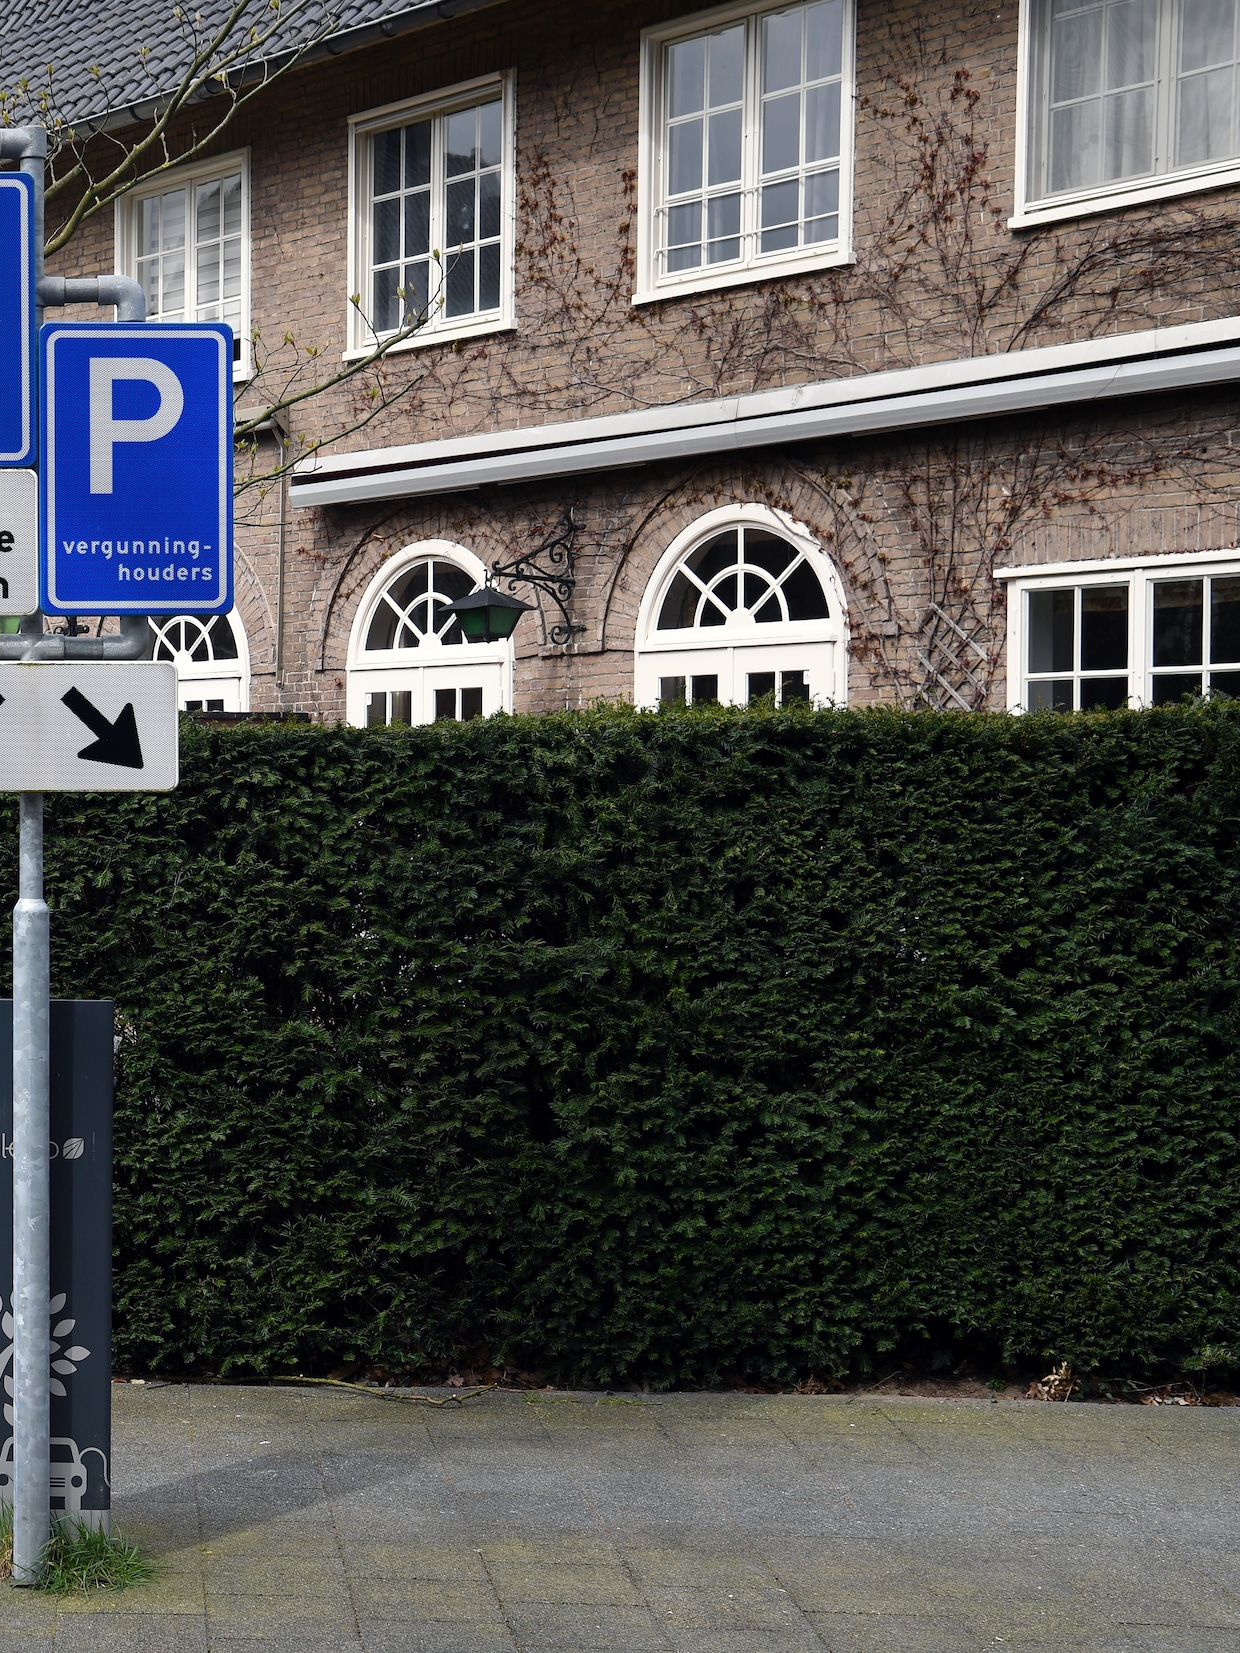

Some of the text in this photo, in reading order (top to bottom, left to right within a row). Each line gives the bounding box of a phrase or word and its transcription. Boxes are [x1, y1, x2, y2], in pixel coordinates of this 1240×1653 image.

[89, 357, 185, 495] P
[62, 537, 212, 560] vergunning-
[117, 563, 213, 581] houders
